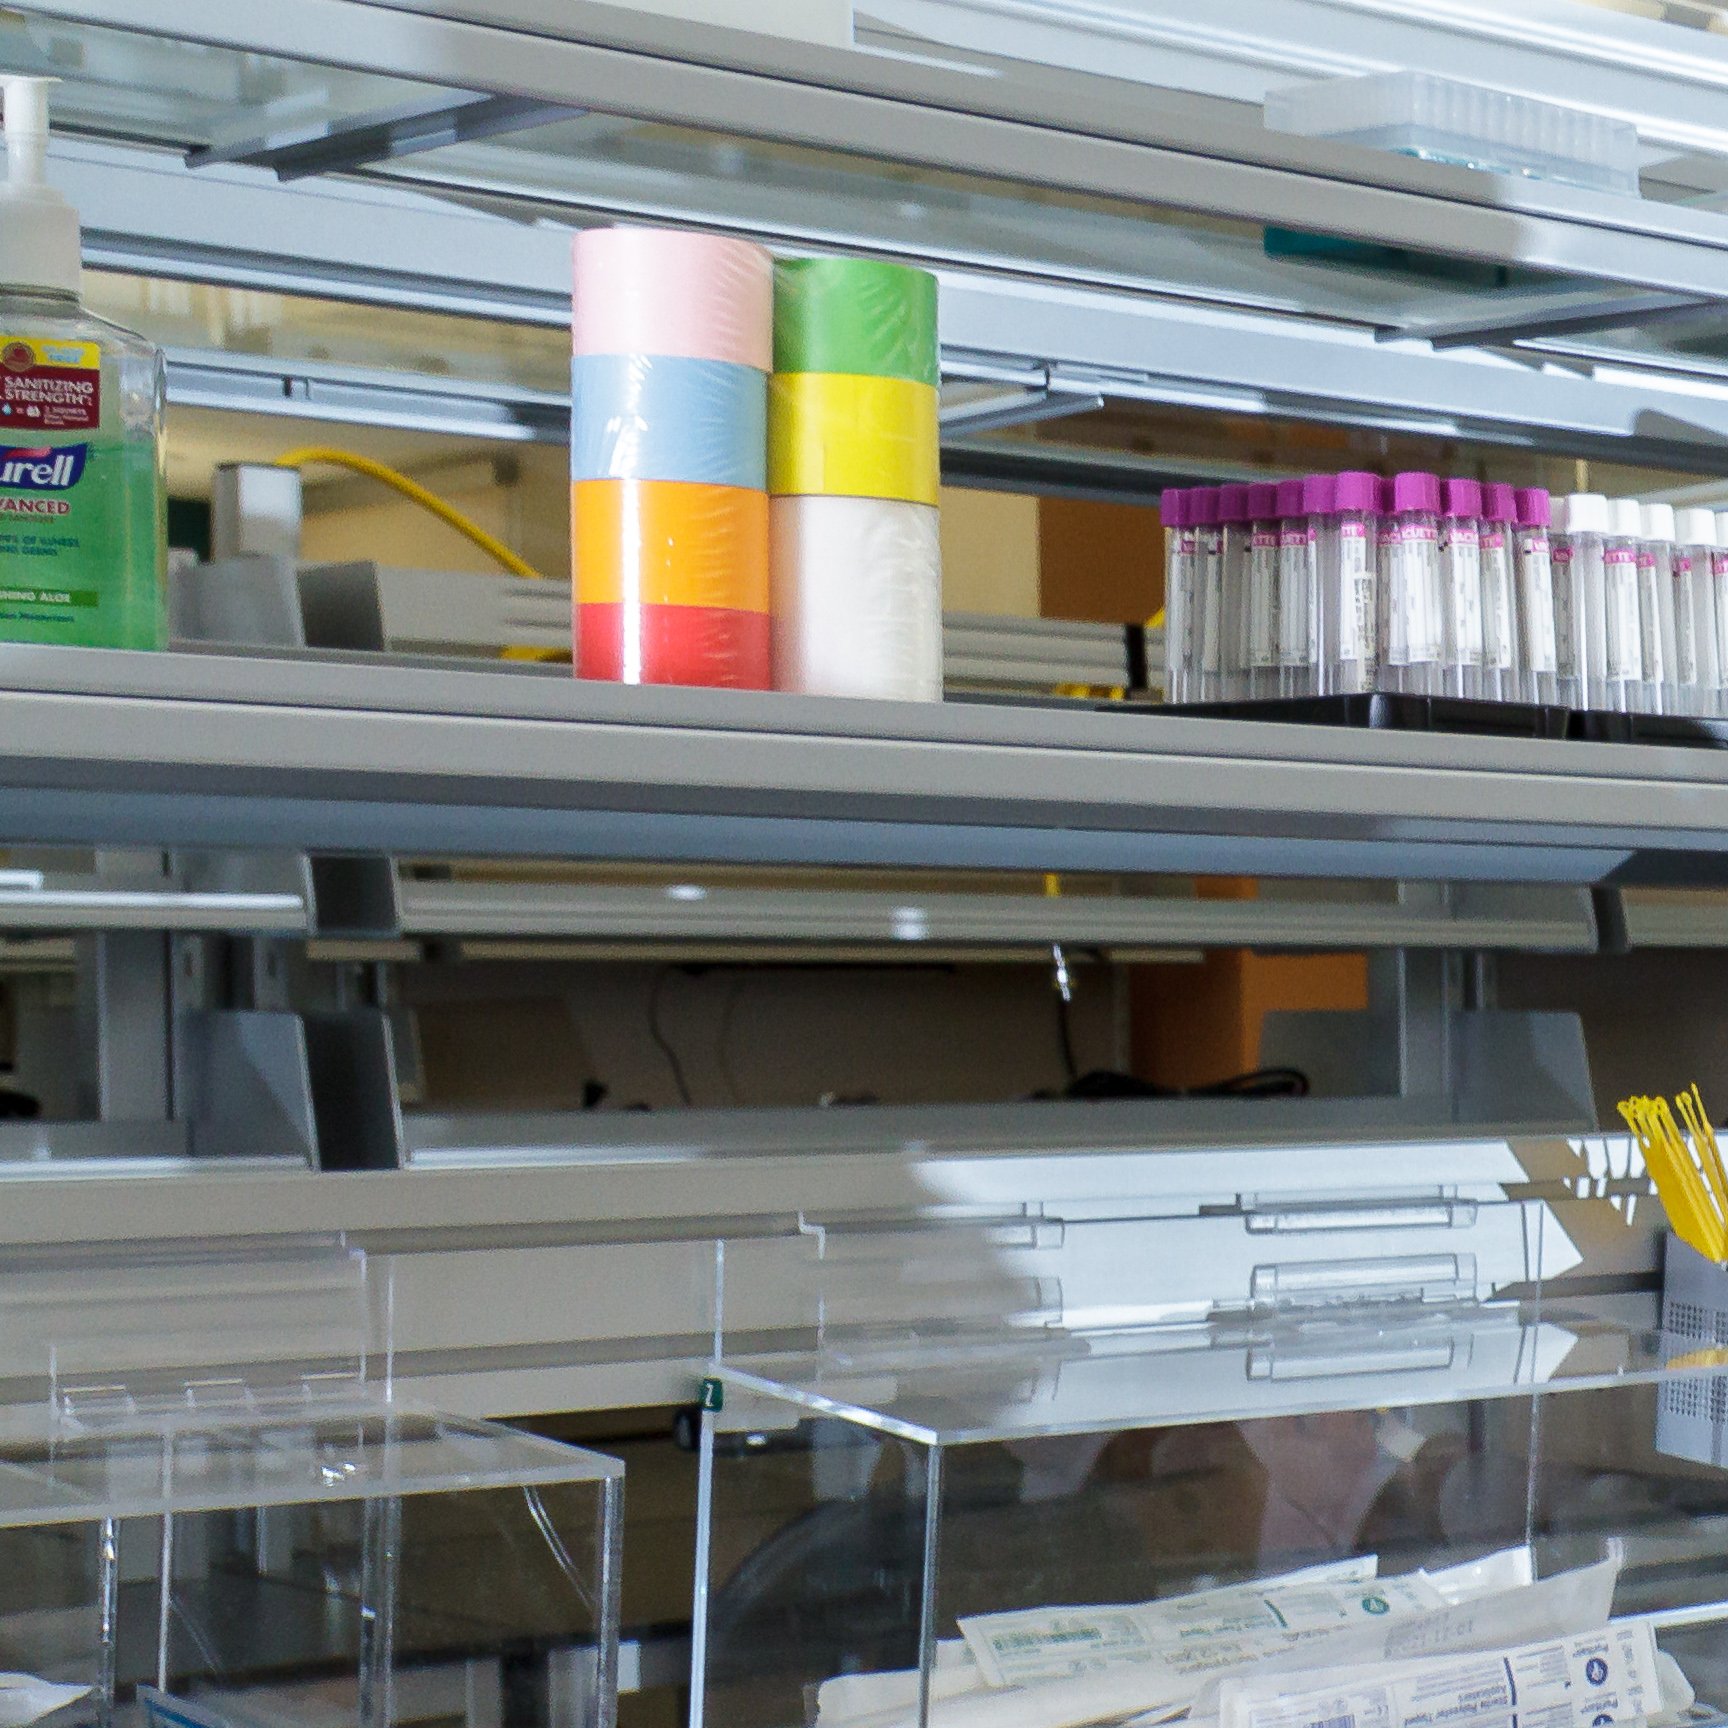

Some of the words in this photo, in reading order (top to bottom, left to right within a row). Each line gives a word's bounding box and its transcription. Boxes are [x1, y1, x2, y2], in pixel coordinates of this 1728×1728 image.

[4, 375, 94, 394] SANITIZING
[0, 454, 75, 486] urell
[0, 499, 71, 515] ANCED
